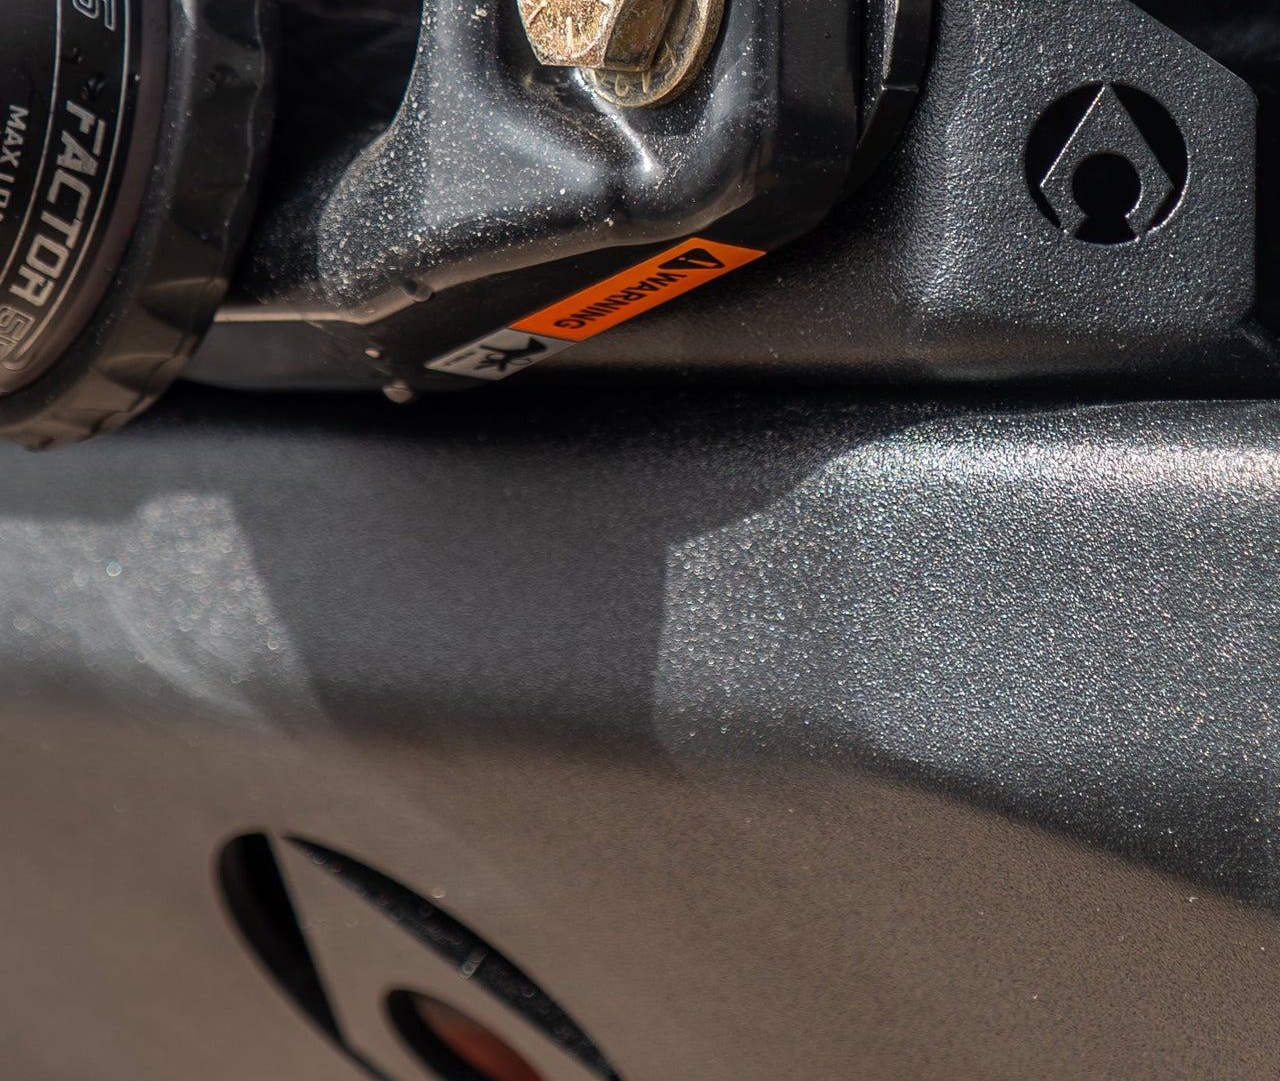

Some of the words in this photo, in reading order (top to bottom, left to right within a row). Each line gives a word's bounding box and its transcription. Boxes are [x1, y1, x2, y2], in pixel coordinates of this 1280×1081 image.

[0, 104, 29, 167] MAX
[9, 100, 106, 307] FACTOR
[554, 272, 687, 330] WARNING
